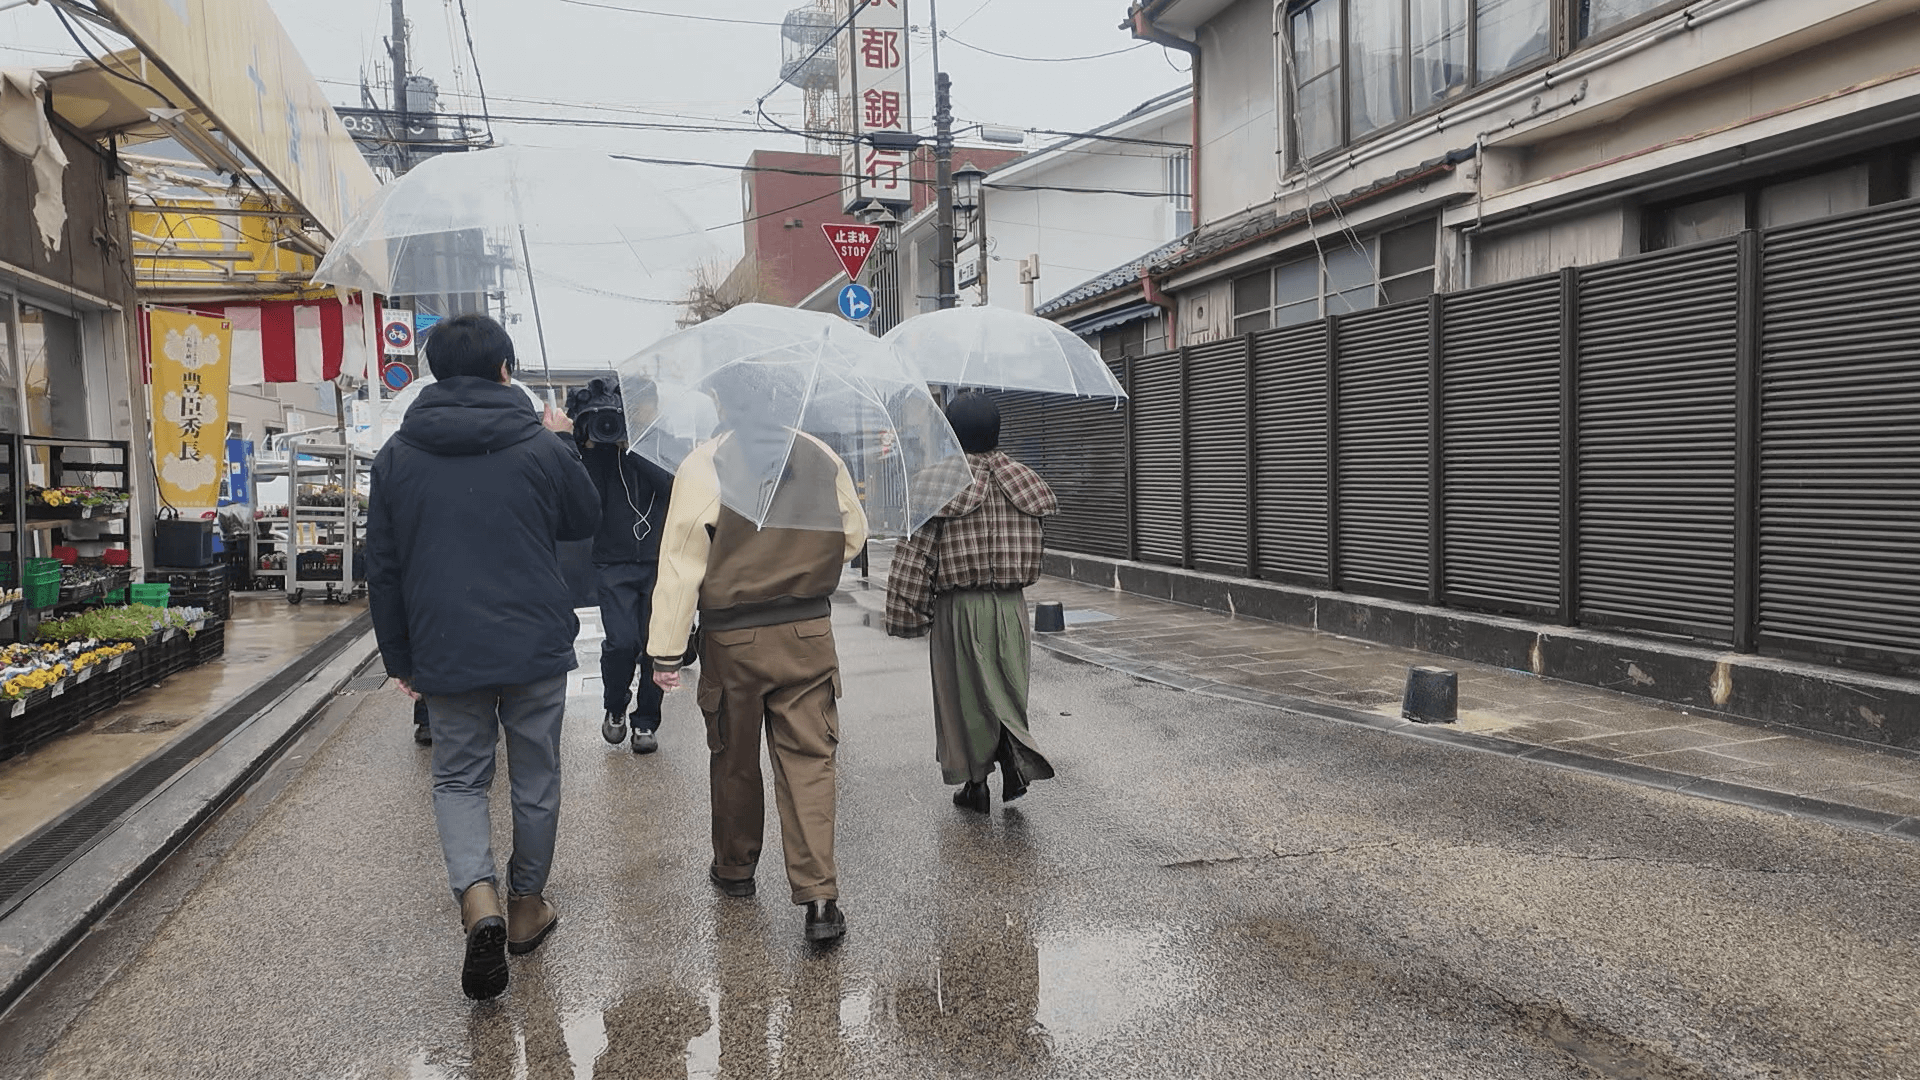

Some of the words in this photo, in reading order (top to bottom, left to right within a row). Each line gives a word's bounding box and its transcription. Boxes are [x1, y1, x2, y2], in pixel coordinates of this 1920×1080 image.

[835, 230, 871, 244] 止まれ
[841, 246, 866, 257] STOP
[178, 371, 203, 462] 豊臣秀長
